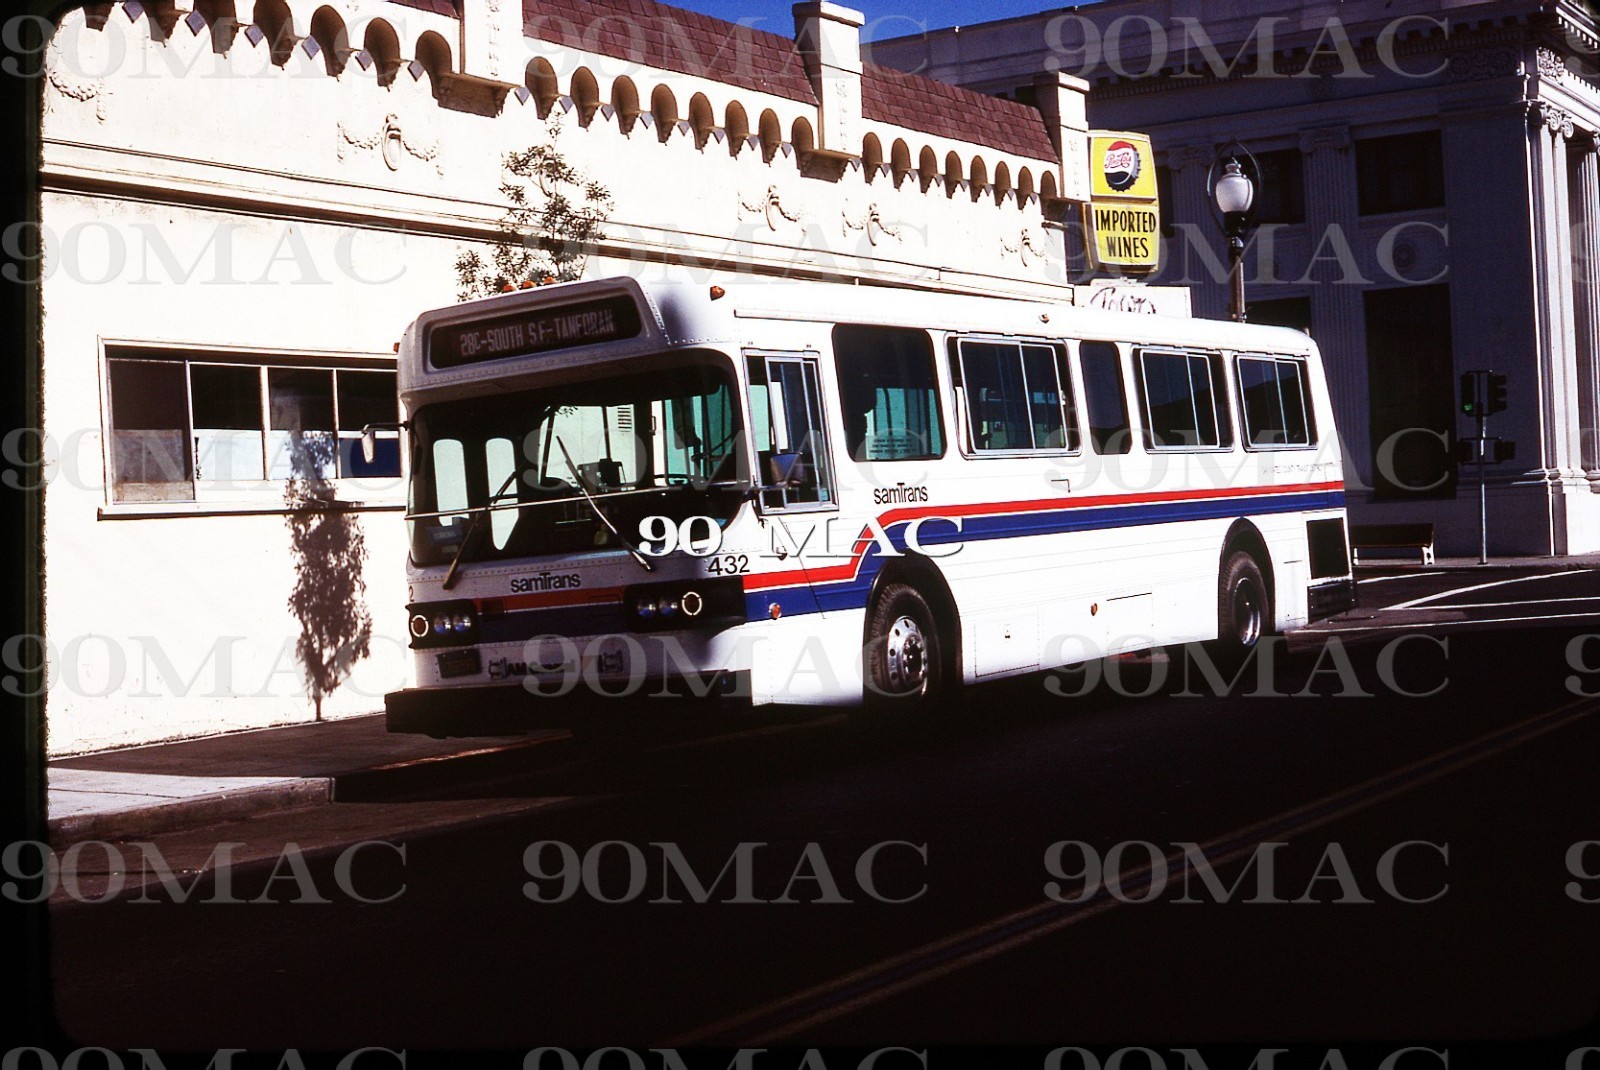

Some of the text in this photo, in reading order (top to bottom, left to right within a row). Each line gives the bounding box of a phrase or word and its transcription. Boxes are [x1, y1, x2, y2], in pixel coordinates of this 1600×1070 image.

[1095, 209, 1156, 232] IMPORTED
[1106, 236, 1149, 258] WINES
[874, 482, 928, 504] samTrans
[708, 555, 750, 575] 432
[511, 572, 581, 593] samTrans
